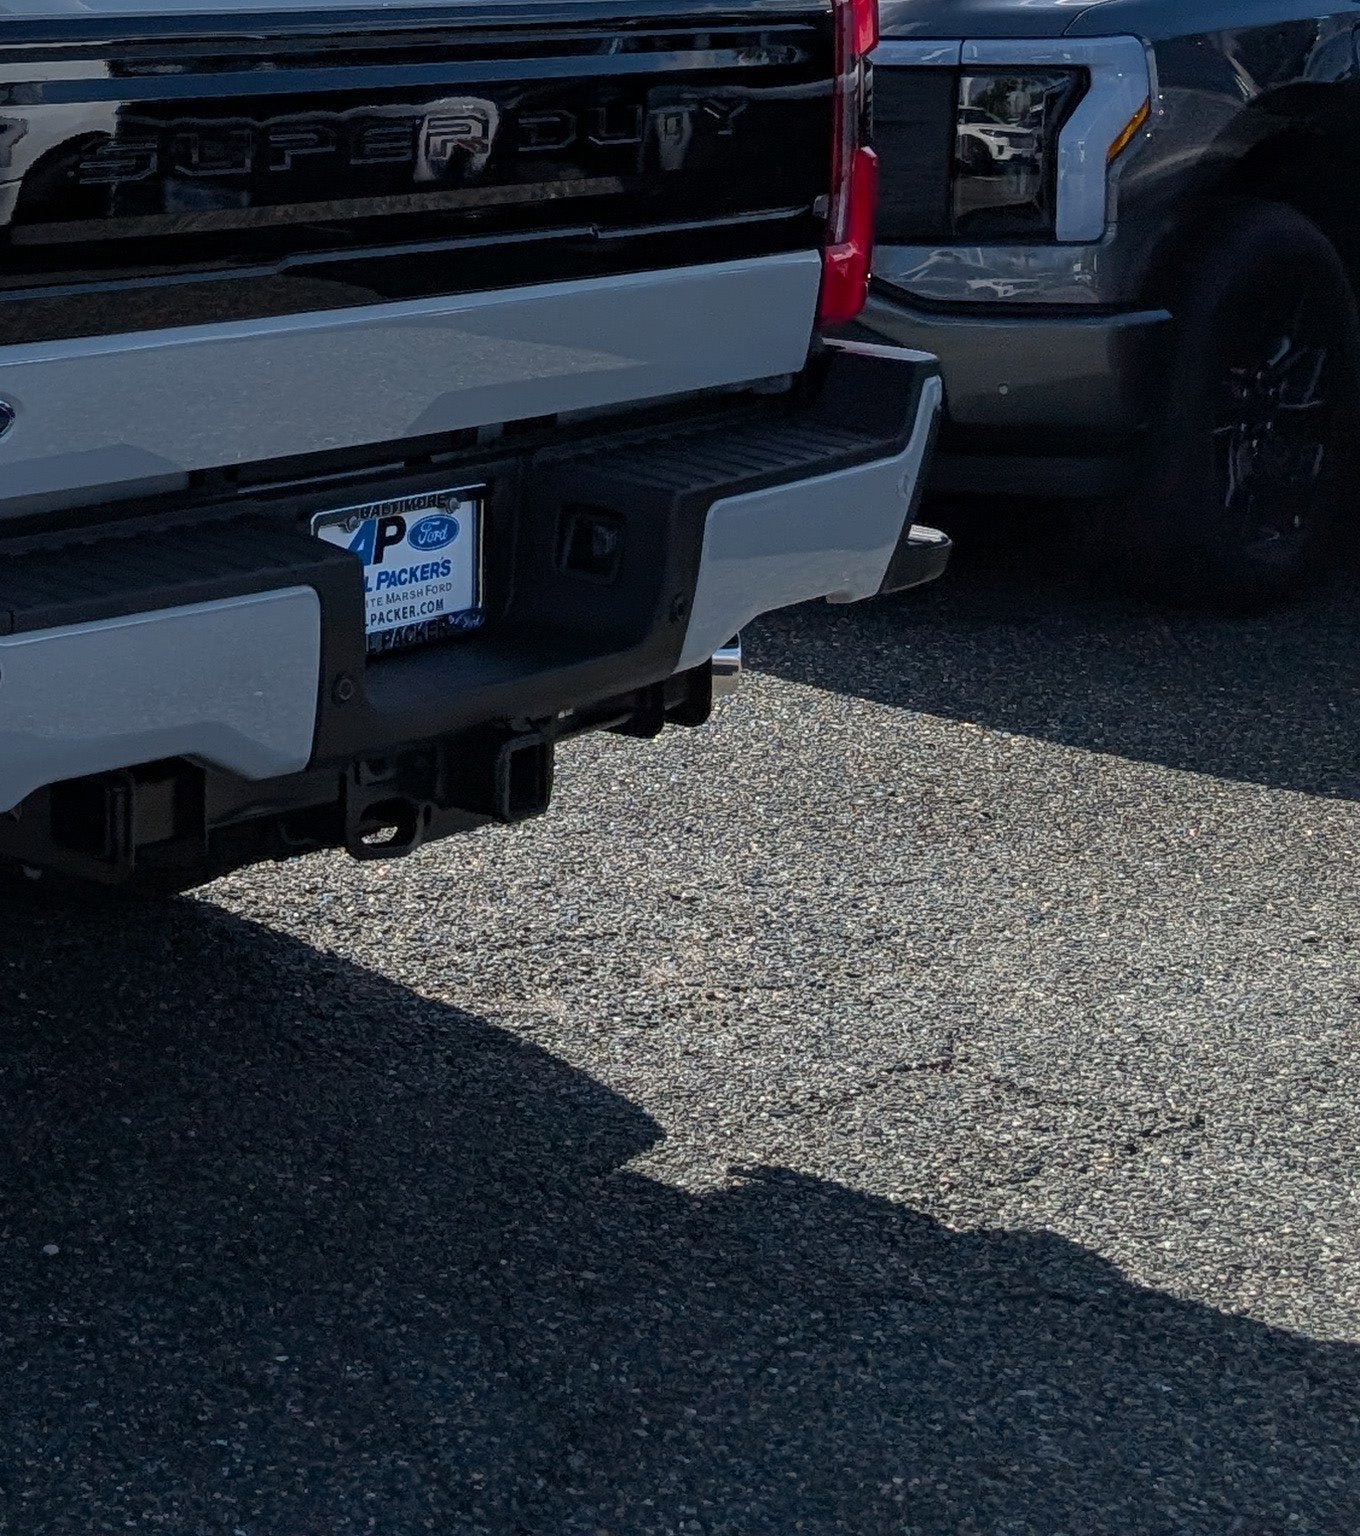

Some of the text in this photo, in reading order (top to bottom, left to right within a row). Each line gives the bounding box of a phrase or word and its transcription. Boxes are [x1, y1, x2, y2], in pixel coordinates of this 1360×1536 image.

[78, 98, 747, 185] SUPER DUTY
[417, 520, 449, 545] Ford
[376, 557, 452, 590] PACKER'S
[385, 588, 424, 605] MARSH
[425, 582, 452, 596] FORD
[365, 598, 444, 627] PACKER.COM
